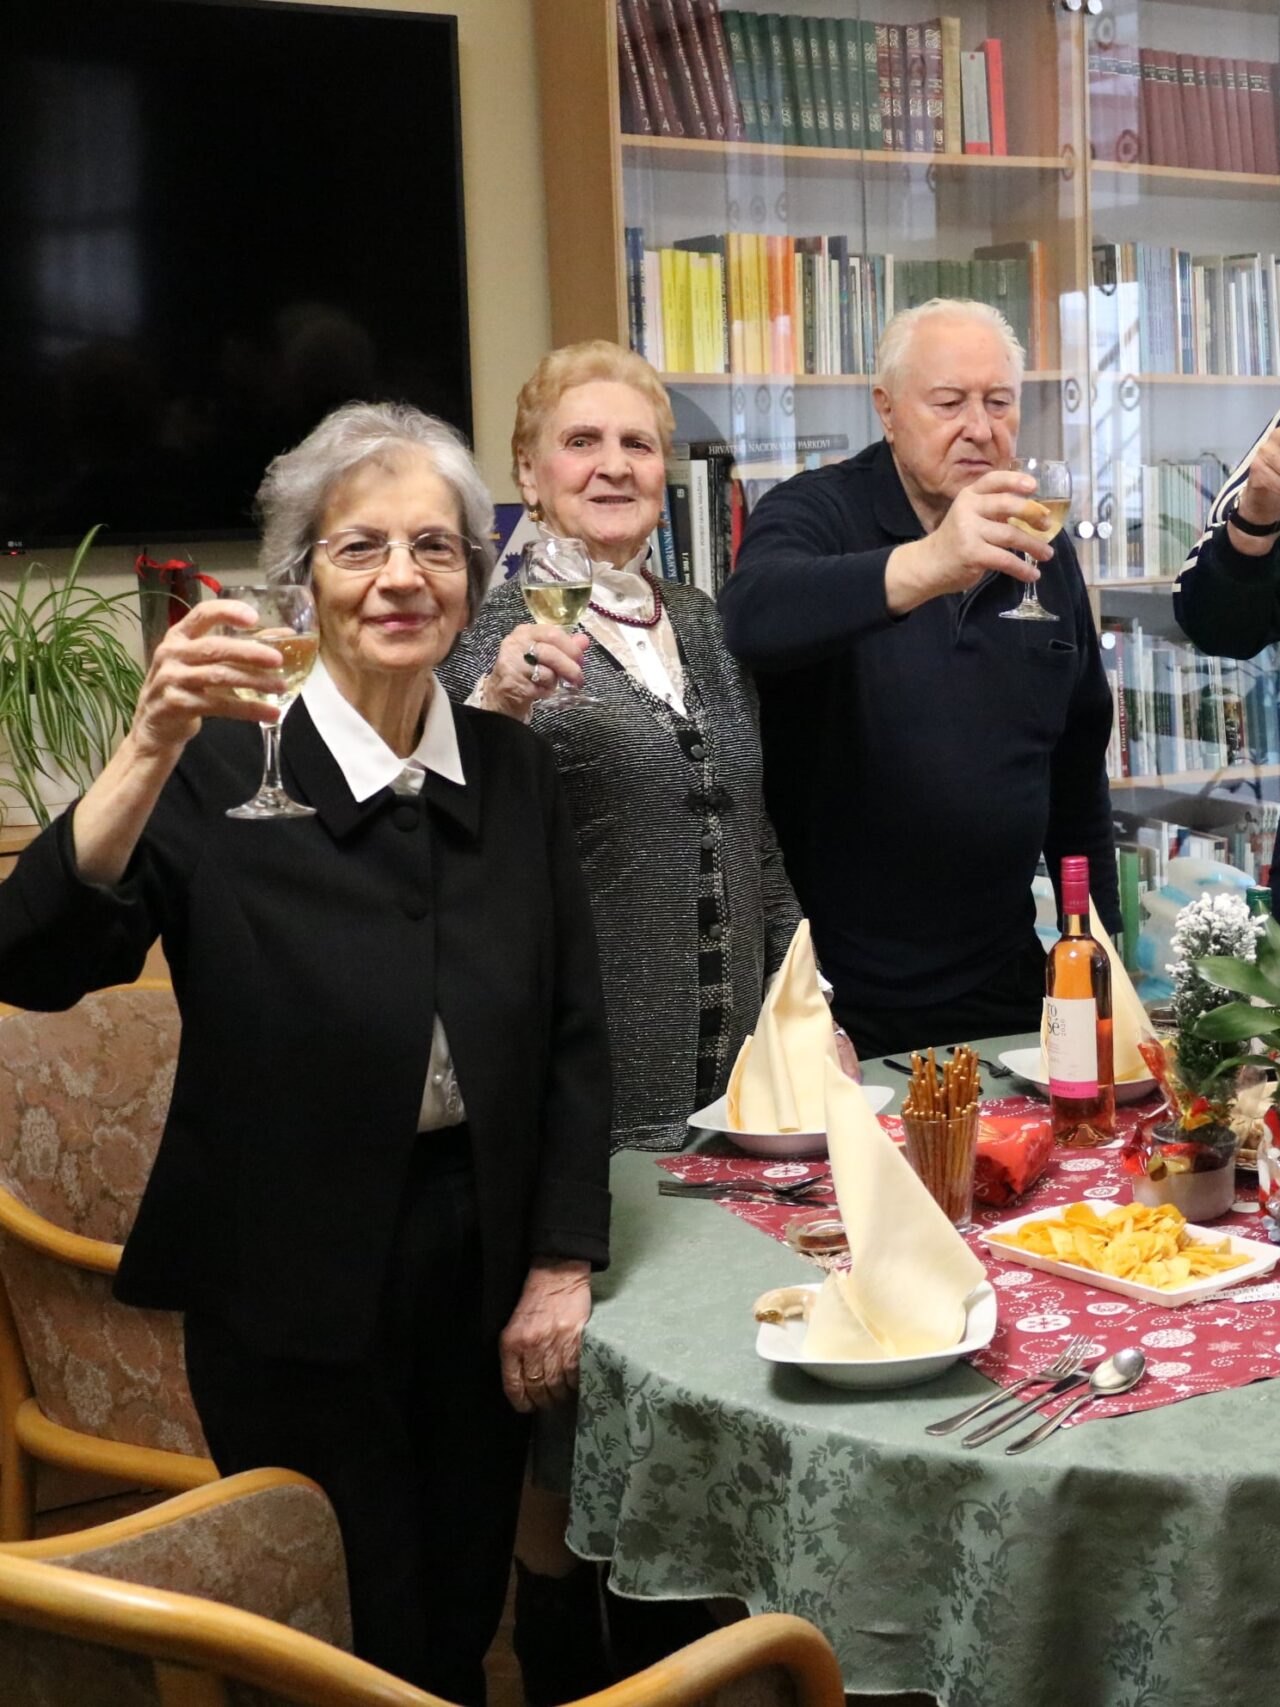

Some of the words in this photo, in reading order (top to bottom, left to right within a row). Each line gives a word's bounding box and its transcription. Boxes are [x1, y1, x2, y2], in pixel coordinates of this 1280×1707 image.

[643, 117, 651, 131] 2
[699, 121, 707, 136] 5
[716, 122, 725, 135] 6
[734, 122, 741, 137] 7
[708, 444, 747, 456] HRVATS
[797, 439, 831, 450] PARKOVI
